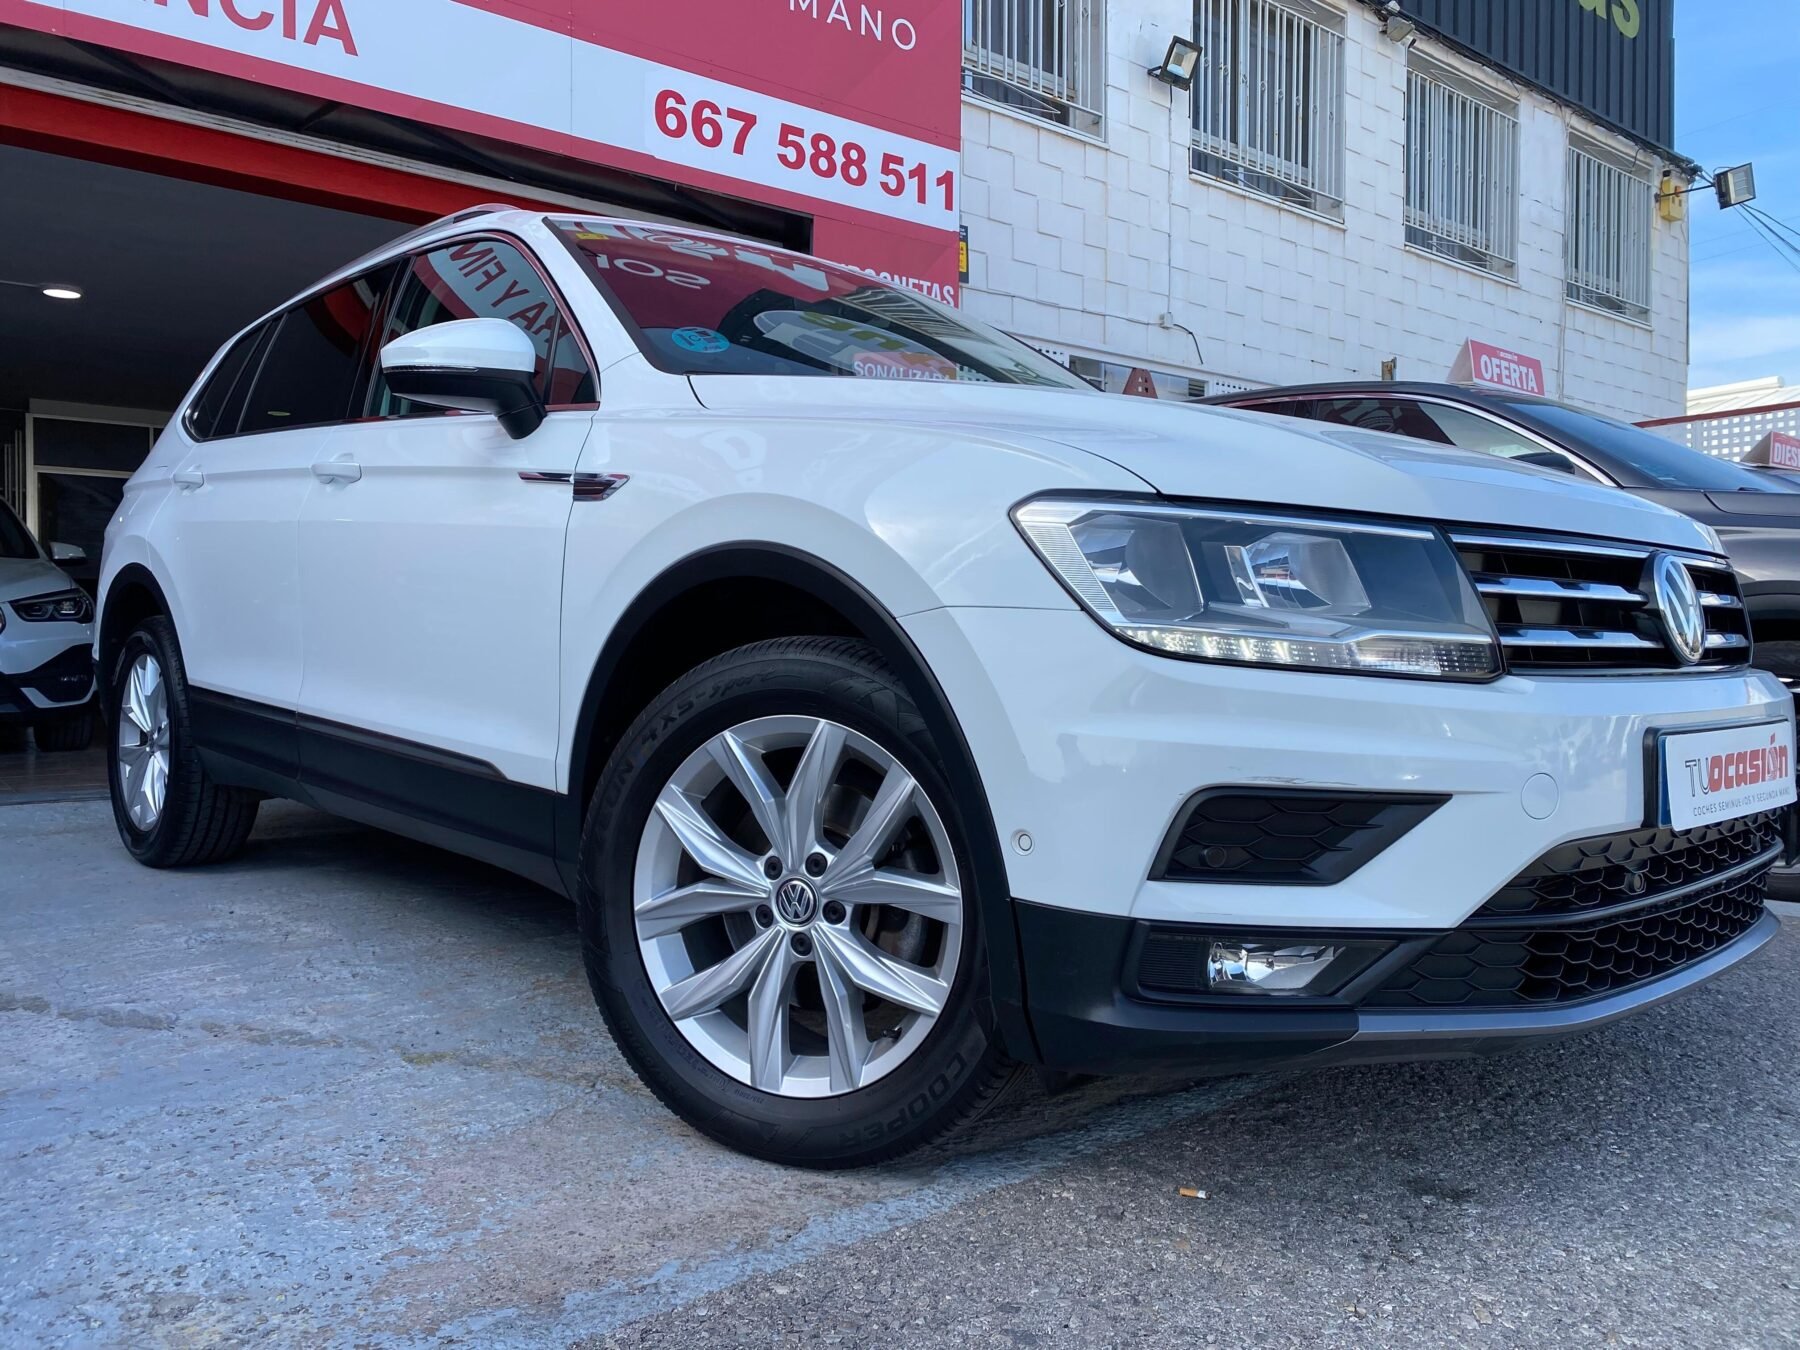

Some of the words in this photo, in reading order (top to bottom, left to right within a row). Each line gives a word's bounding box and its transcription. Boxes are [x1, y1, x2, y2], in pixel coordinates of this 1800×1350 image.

[654, 89, 757, 156] 667
[777, 123, 868, 187] 588
[879, 152, 954, 212] 511
[1480, 354, 1539, 393] OFERTA
[1773, 442, 1800, 468] DIES
[1693, 803, 1718, 817] COCHES
